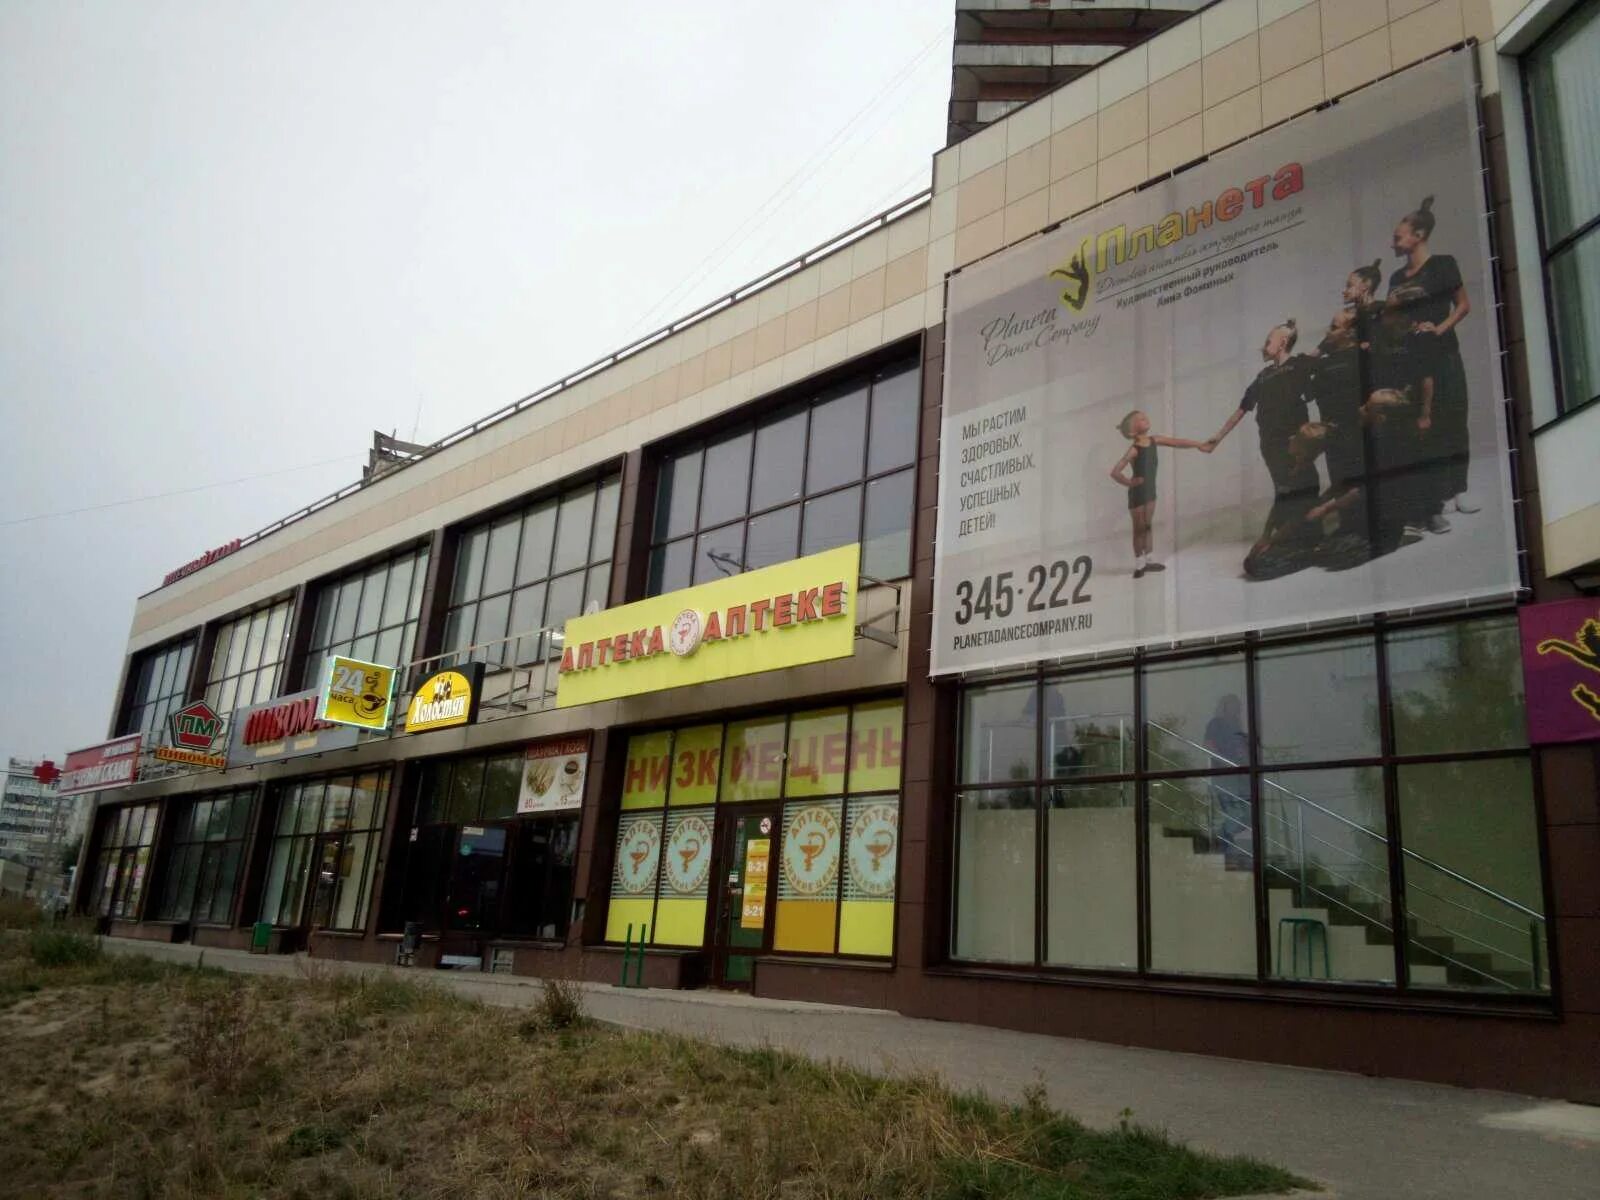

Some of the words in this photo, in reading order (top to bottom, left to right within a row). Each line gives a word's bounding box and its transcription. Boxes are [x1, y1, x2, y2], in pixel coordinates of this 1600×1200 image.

[1095, 162, 1305, 274] Планета
[1115, 268, 1201, 309] Художественный
[1203, 240, 1280, 278] руководитель
[1156, 291, 1183, 308] Анна
[1184, 271, 1235, 298] Фоминых
[980, 307, 1057, 352] Planeta
[961, 421, 981, 441] МЫ
[983, 405, 1027, 434] РАСТИМ
[960, 431, 1024, 465] ЗДОРОВЫХ,
[960, 452, 1037, 488] СЧАСТЛИВЫХ,
[959, 481, 1022, 513] УСПЕШНЫХ
[958, 511, 997, 539] ДЕТЕЙ!
[701, 579, 847, 644] АПТЕКЕ
[558, 624, 666, 675] АПТЕКА
[952, 613, 1094, 651] PLANETADANCECOMPANY.RU
[330, 692, 355, 705] часа
[333, 666, 365, 696] 24
[179, 715, 217, 737] ПМ
[243, 695, 336, 746] ПИВОМ
[411, 694, 467, 726] Холостяк
[157, 746, 226, 769] ПИВОМАН
[624, 740, 782, 794] НИЗКИЕ
[791, 809, 837, 841] АПТЕКА
